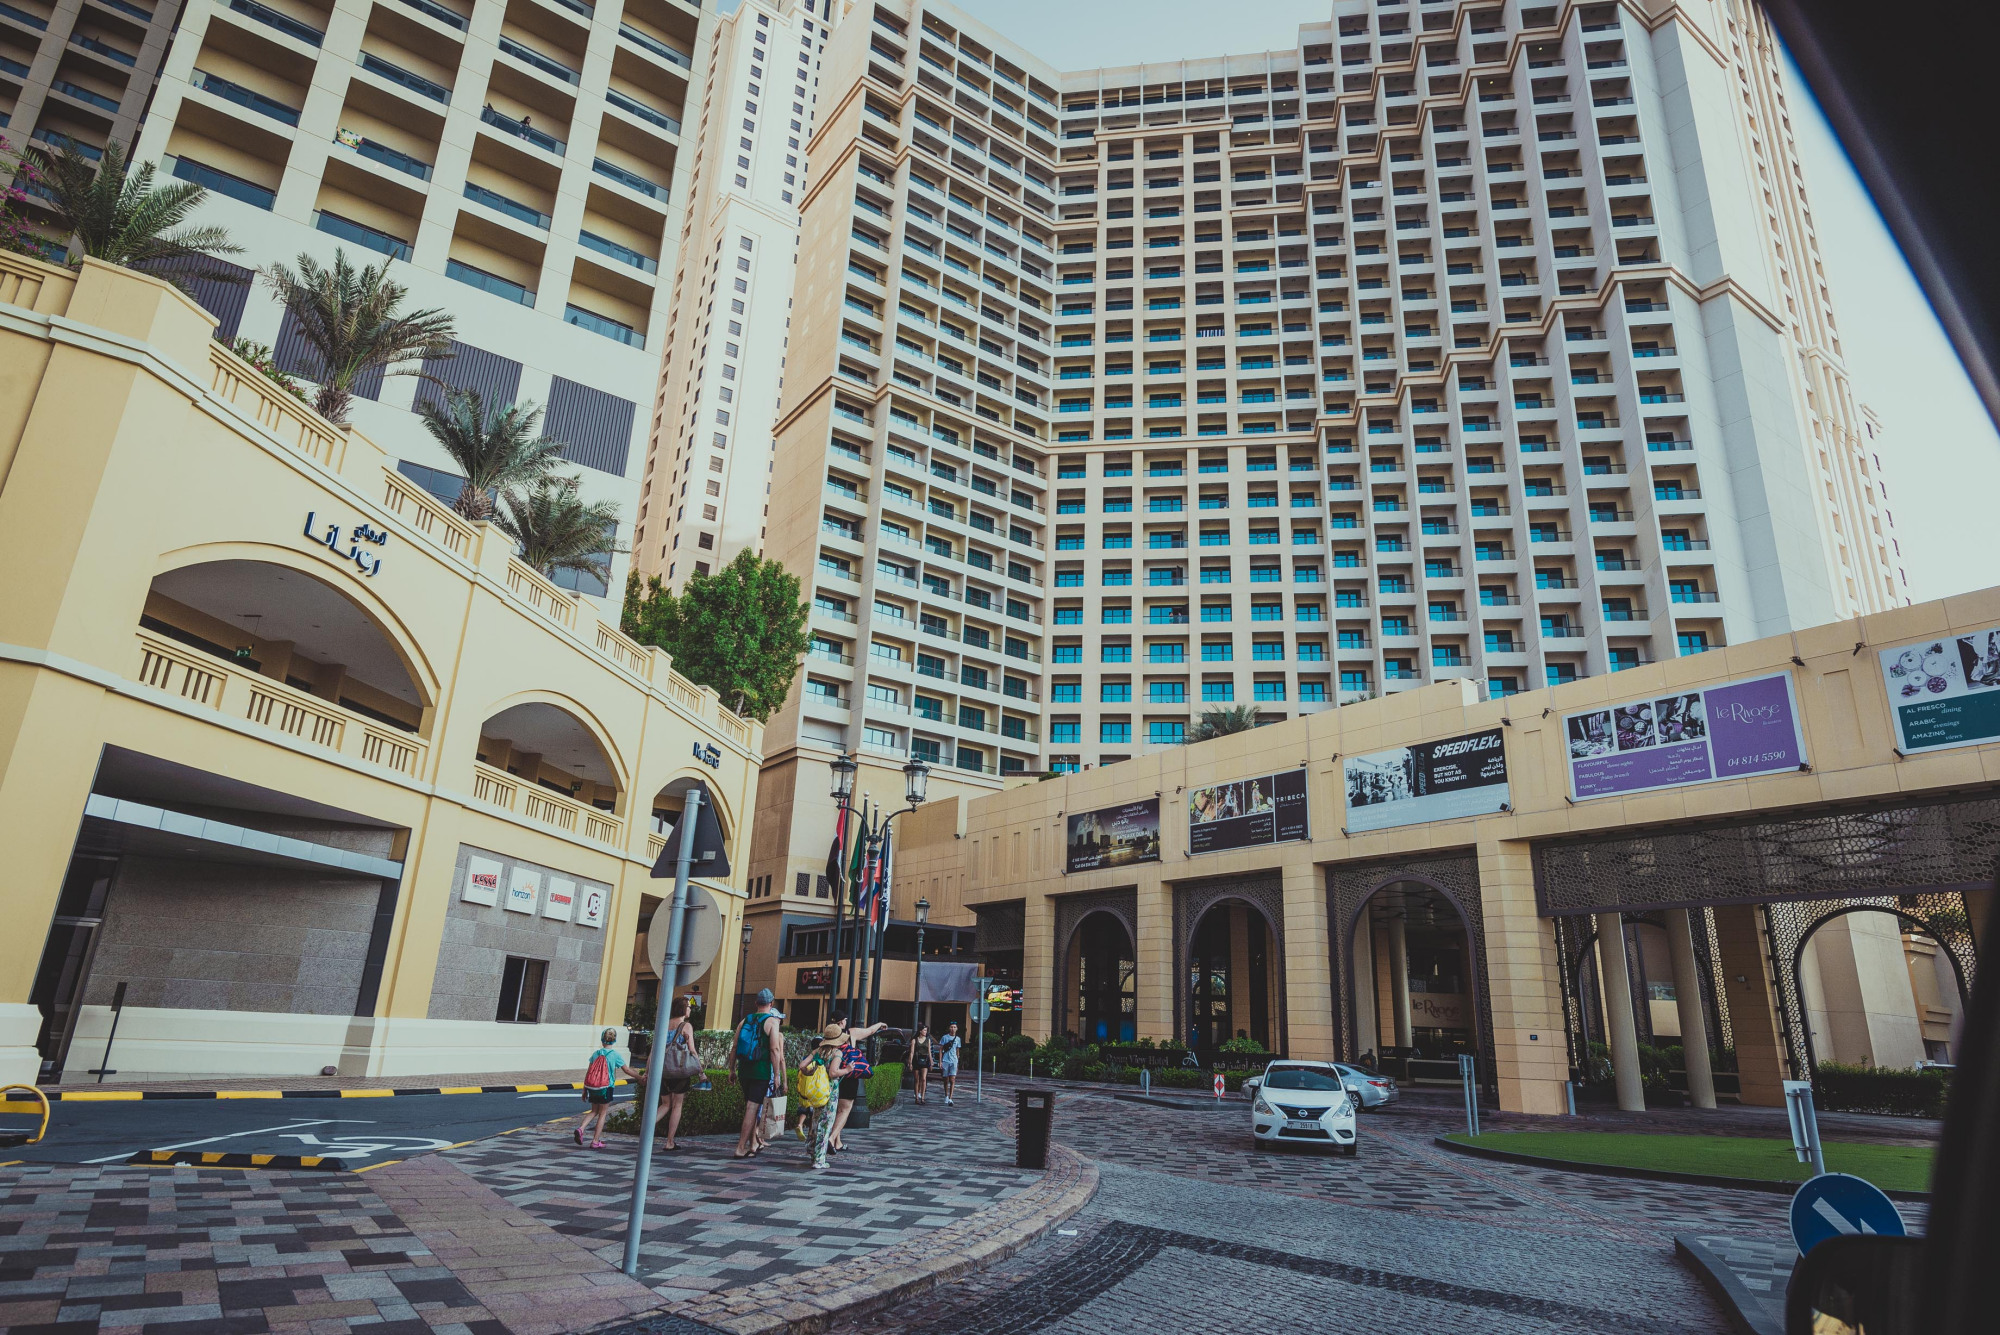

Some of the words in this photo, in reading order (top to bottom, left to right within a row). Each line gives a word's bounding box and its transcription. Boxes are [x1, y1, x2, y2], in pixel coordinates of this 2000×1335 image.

[303, 511, 382, 577] روتانا
[1917, 702, 1946, 713] FRESCO
[1941, 705, 1962, 714] dining
[1909, 717, 1937, 727] ARABIC
[1933, 720, 1960, 729] evenings
[1911, 730, 1946, 740] AMAZING
[1432, 735, 1496, 759] SPEEDFLEX
[1728, 758, 1739, 767] 04
[1741, 755, 1759, 765] 814
[1761, 751, 1786, 762] 5590
